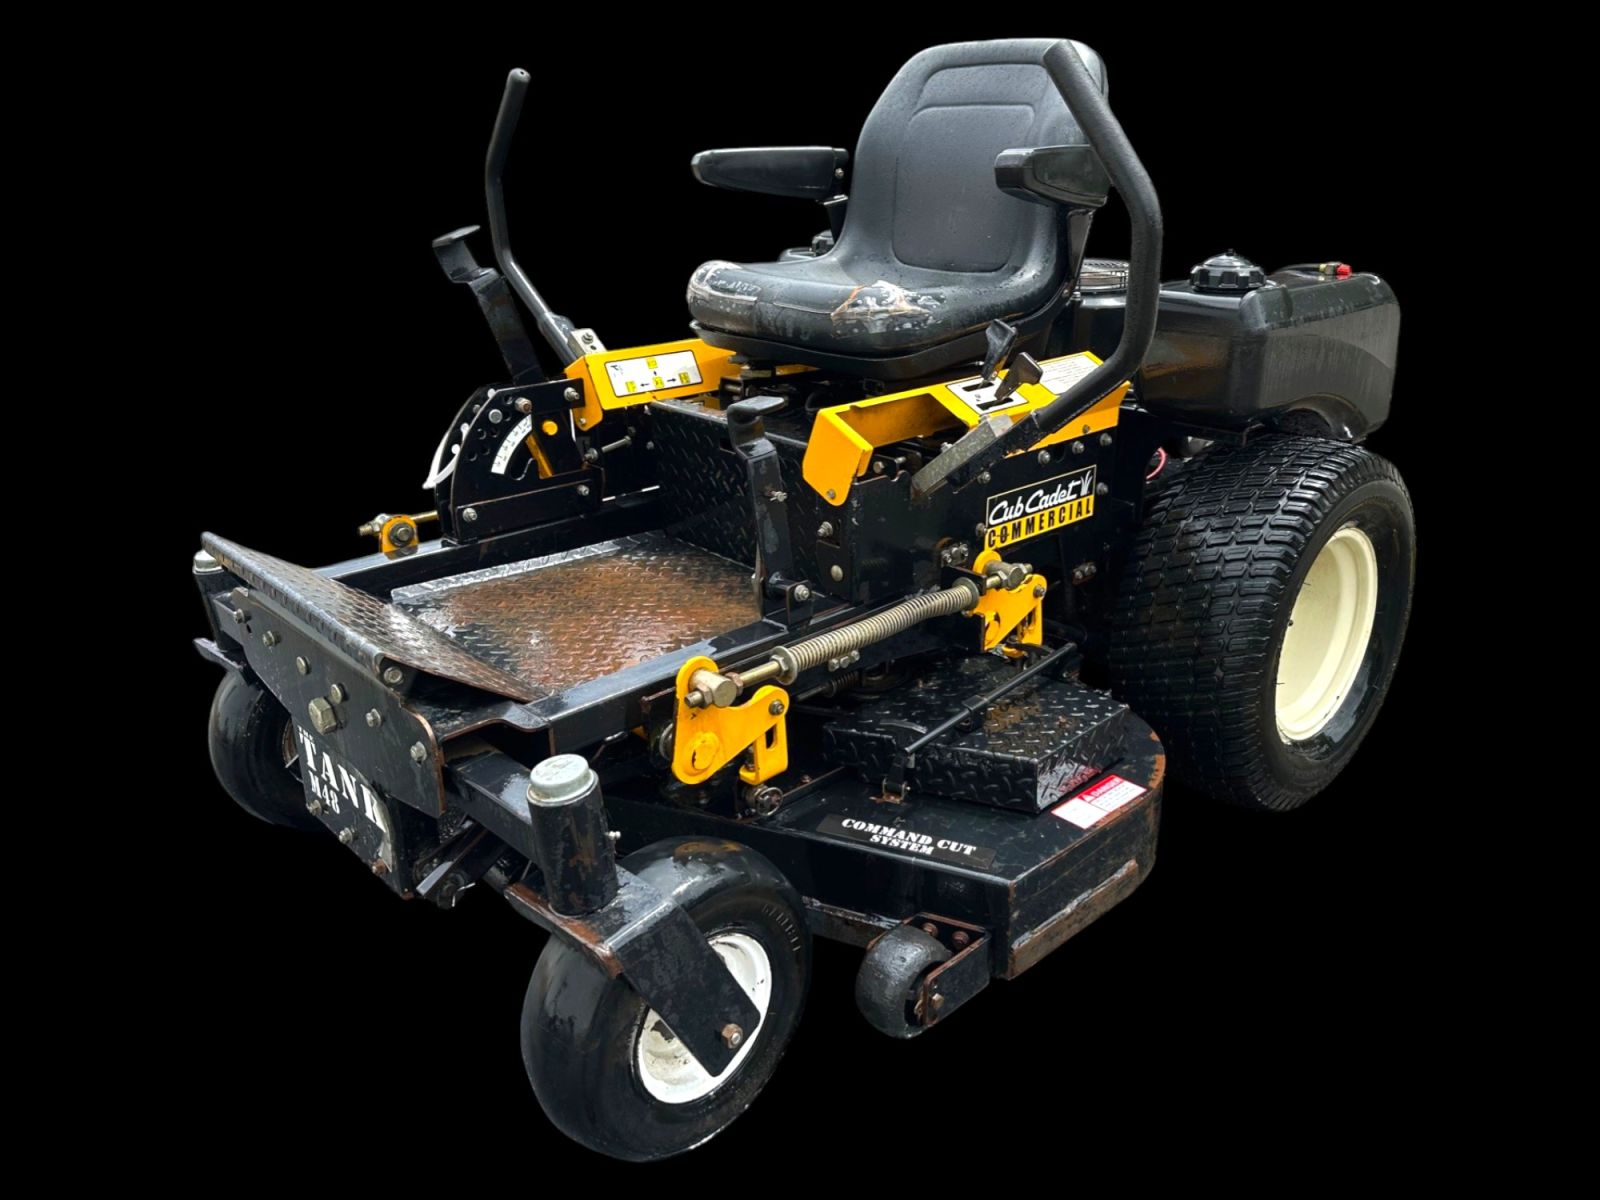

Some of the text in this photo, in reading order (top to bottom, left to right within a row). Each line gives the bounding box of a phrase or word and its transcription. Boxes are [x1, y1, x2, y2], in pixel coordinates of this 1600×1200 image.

[988, 499, 1091, 548] COMMERCIAL
[989, 480, 1081, 525] Cub Cadet
[309, 770, 340, 814] M48
[841, 818, 976, 856] COMMAND CUT
[870, 834, 934, 855] SYSTEM
